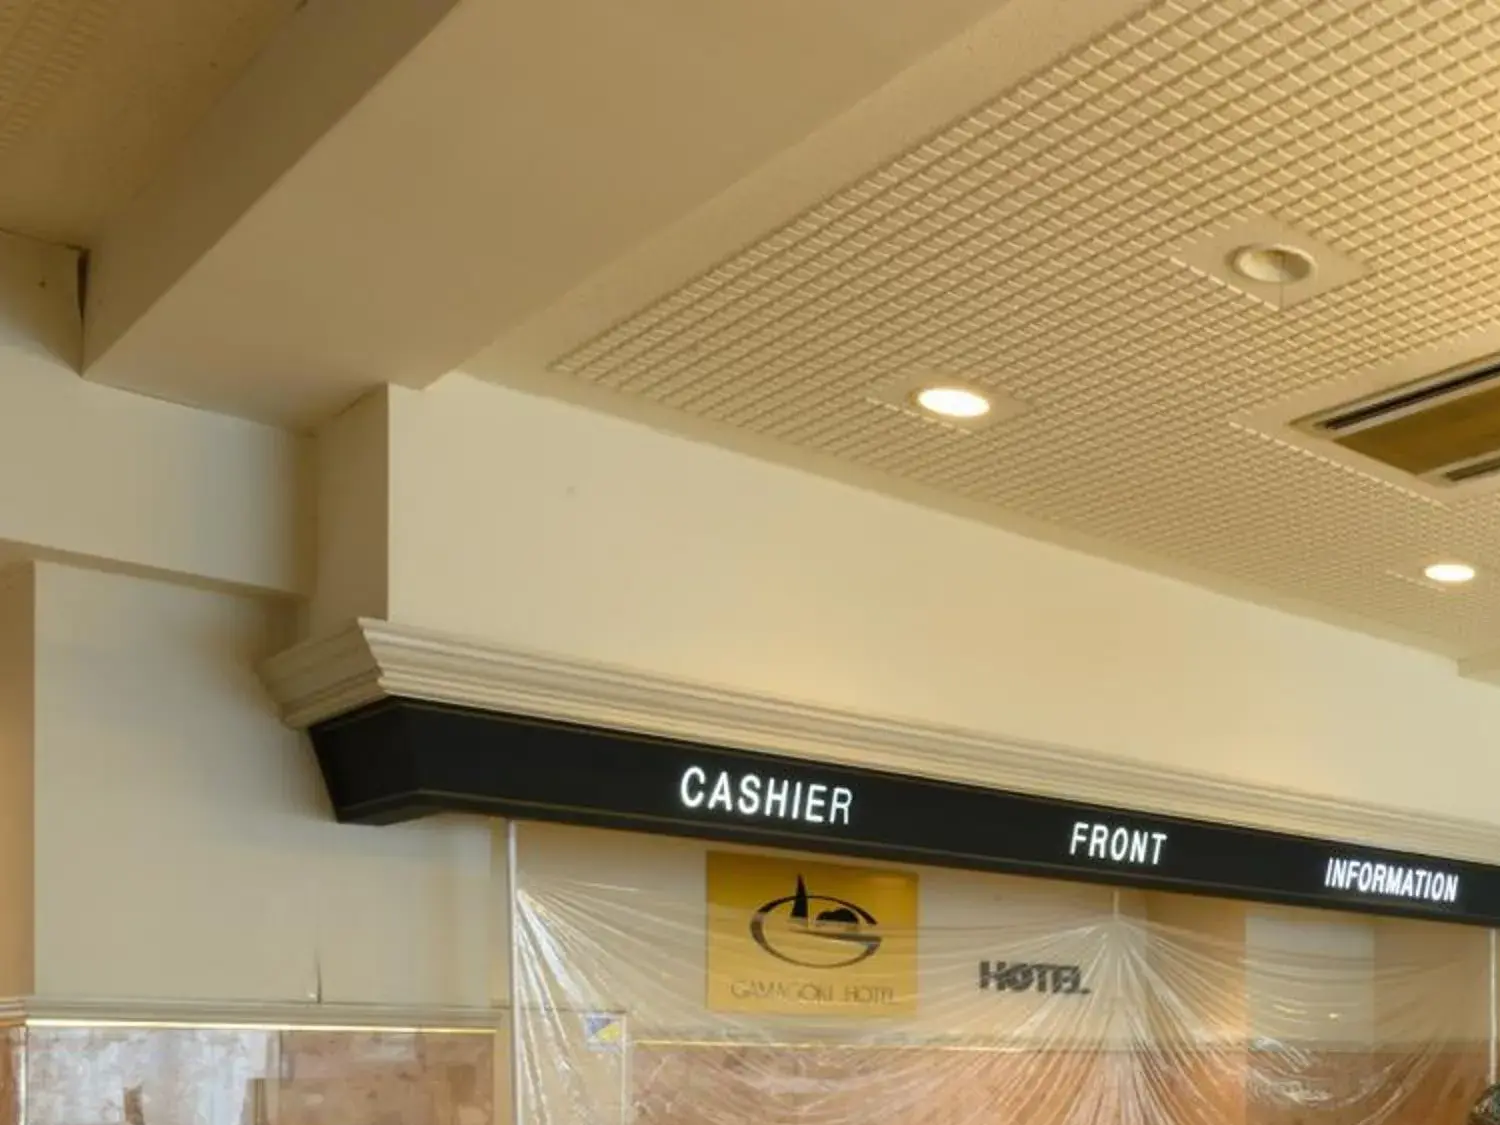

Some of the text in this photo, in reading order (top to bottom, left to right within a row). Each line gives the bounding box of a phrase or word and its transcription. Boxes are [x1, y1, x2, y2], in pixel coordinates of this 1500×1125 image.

[681, 766, 853, 825] CASHIER
[1069, 822, 1168, 865] FRONT
[1324, 857, 1460, 902] INFORMATION
[979, 961, 1091, 995] HOTEL
